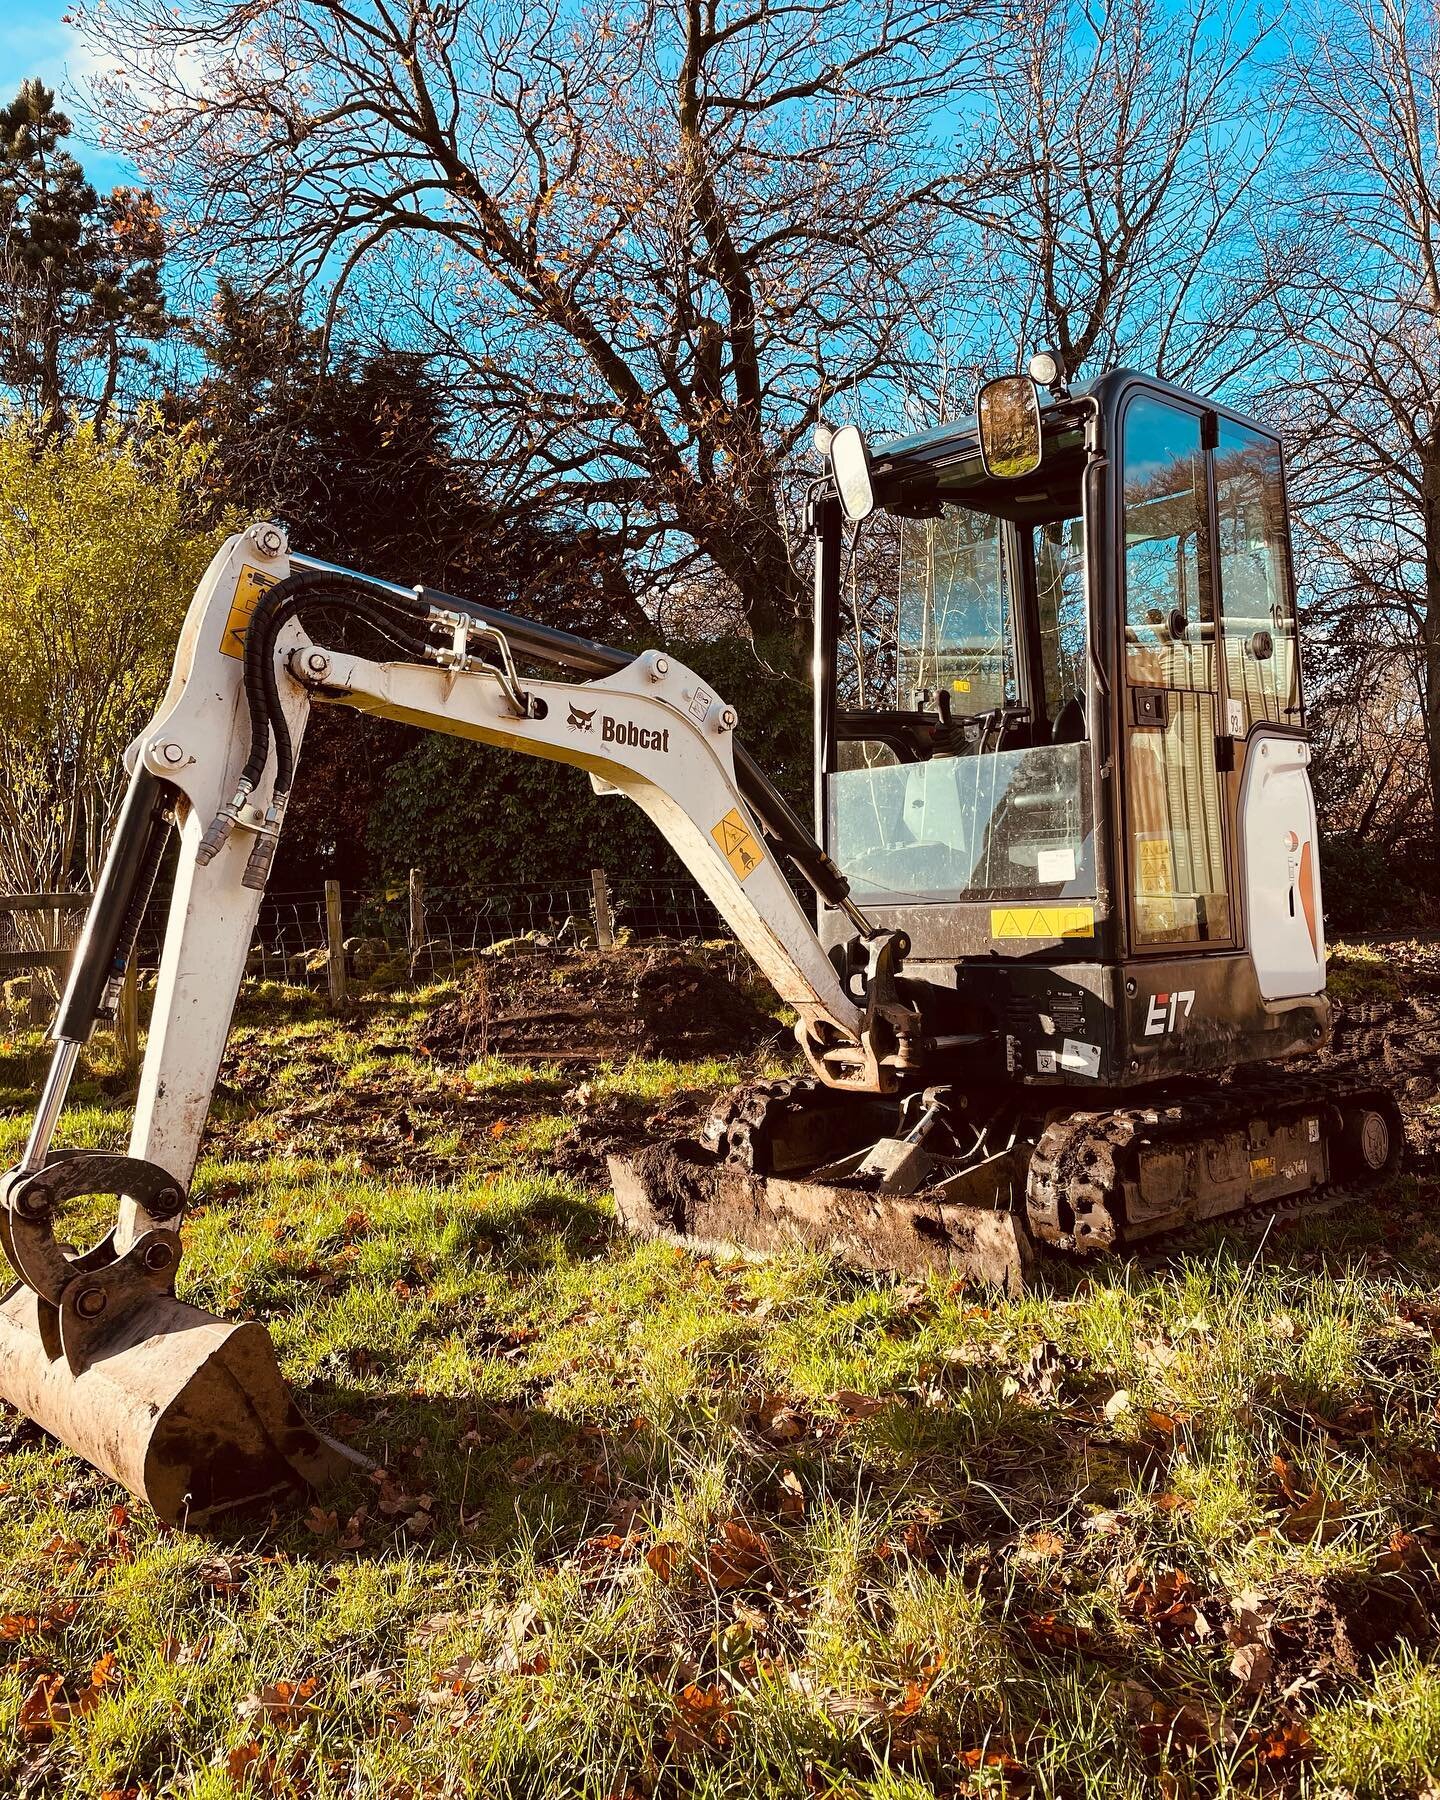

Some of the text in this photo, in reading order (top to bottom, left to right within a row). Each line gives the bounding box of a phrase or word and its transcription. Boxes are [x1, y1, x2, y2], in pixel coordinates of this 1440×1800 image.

[1269, 603, 1283, 630] 16
[601, 715, 670, 753] Bobcat
[1231, 715, 1239, 732] 93
[1144, 990, 1196, 1036] E17
